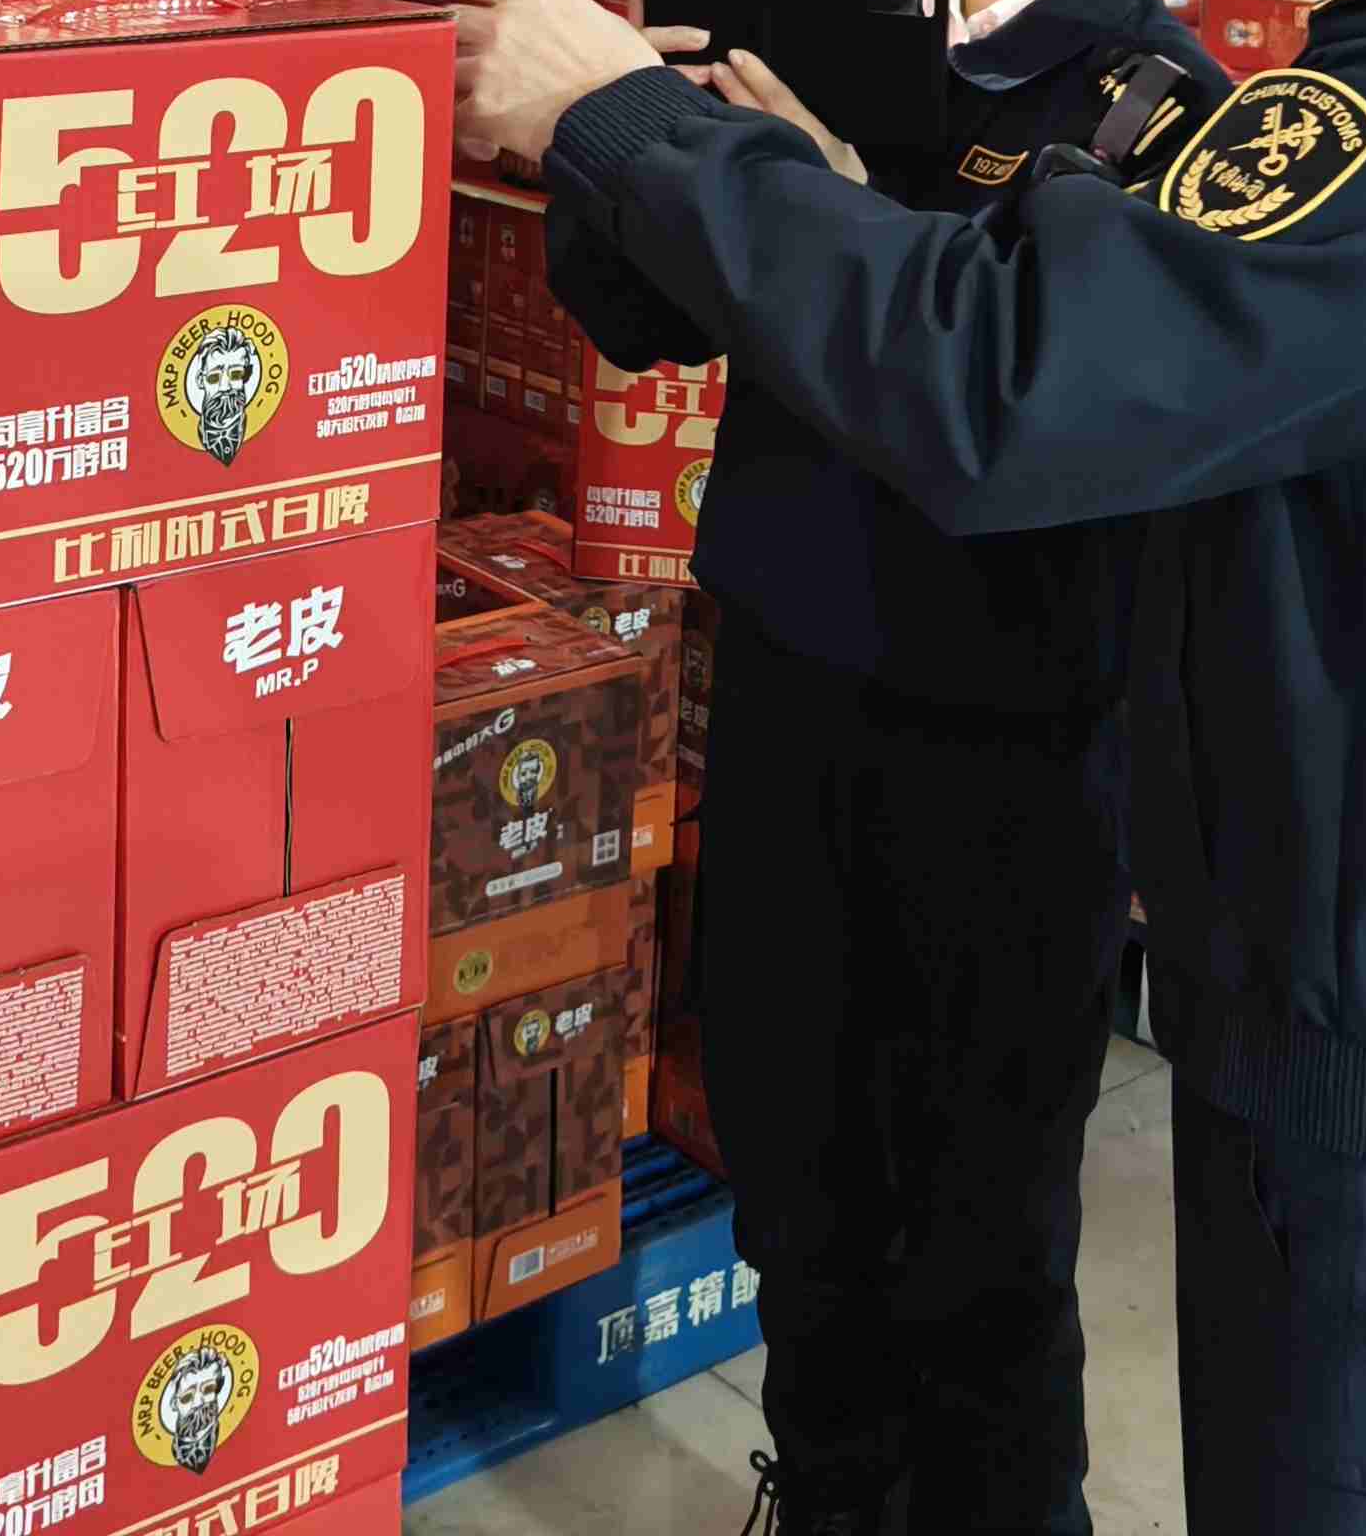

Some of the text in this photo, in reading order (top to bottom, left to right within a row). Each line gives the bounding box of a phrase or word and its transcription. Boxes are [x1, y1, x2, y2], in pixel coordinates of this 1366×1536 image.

[1240, 82, 1364, 152] CHINA CUSTOMS
[117, 150, 331, 232] 红场
[172, 318, 211, 360] BEER
[227, 310, 276, 347] HOOD
[266, 364, 282, 396] OG
[54, 484, 369, 584] 比利时式白啤
[223, 586, 345, 676] 老皮
[254, 660, 319, 700] MR.P
[92, 1160, 302, 1295] 红场
[149, 1345, 185, 1392] BEER
[199, 1331, 246, 1356] HOOD
[236, 1368, 253, 1400] OG
